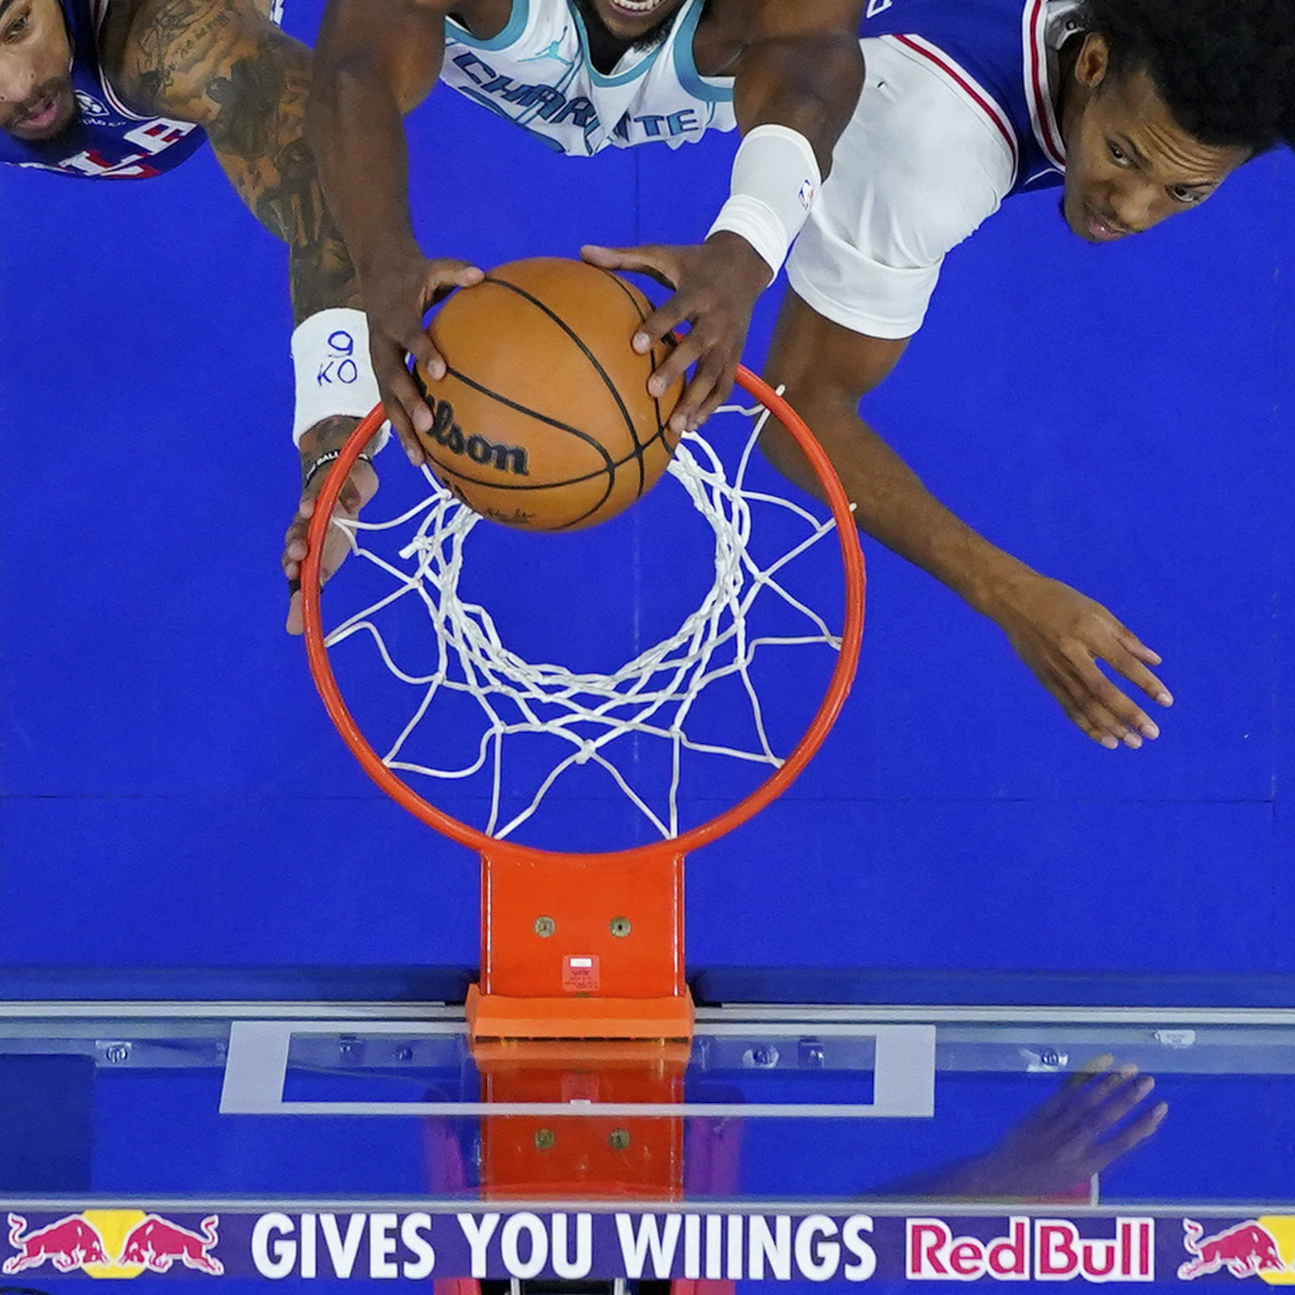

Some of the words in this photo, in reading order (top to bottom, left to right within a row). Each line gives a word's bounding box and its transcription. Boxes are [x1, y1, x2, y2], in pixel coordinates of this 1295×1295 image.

[252, 1212, 435, 1280] GIVES
[456, 1212, 593, 1280] YOU
[614, 1213, 878, 1282] WIIINGS
[908, 1220, 1027, 1277] Red
[1036, 1220, 1152, 1278] Bull
